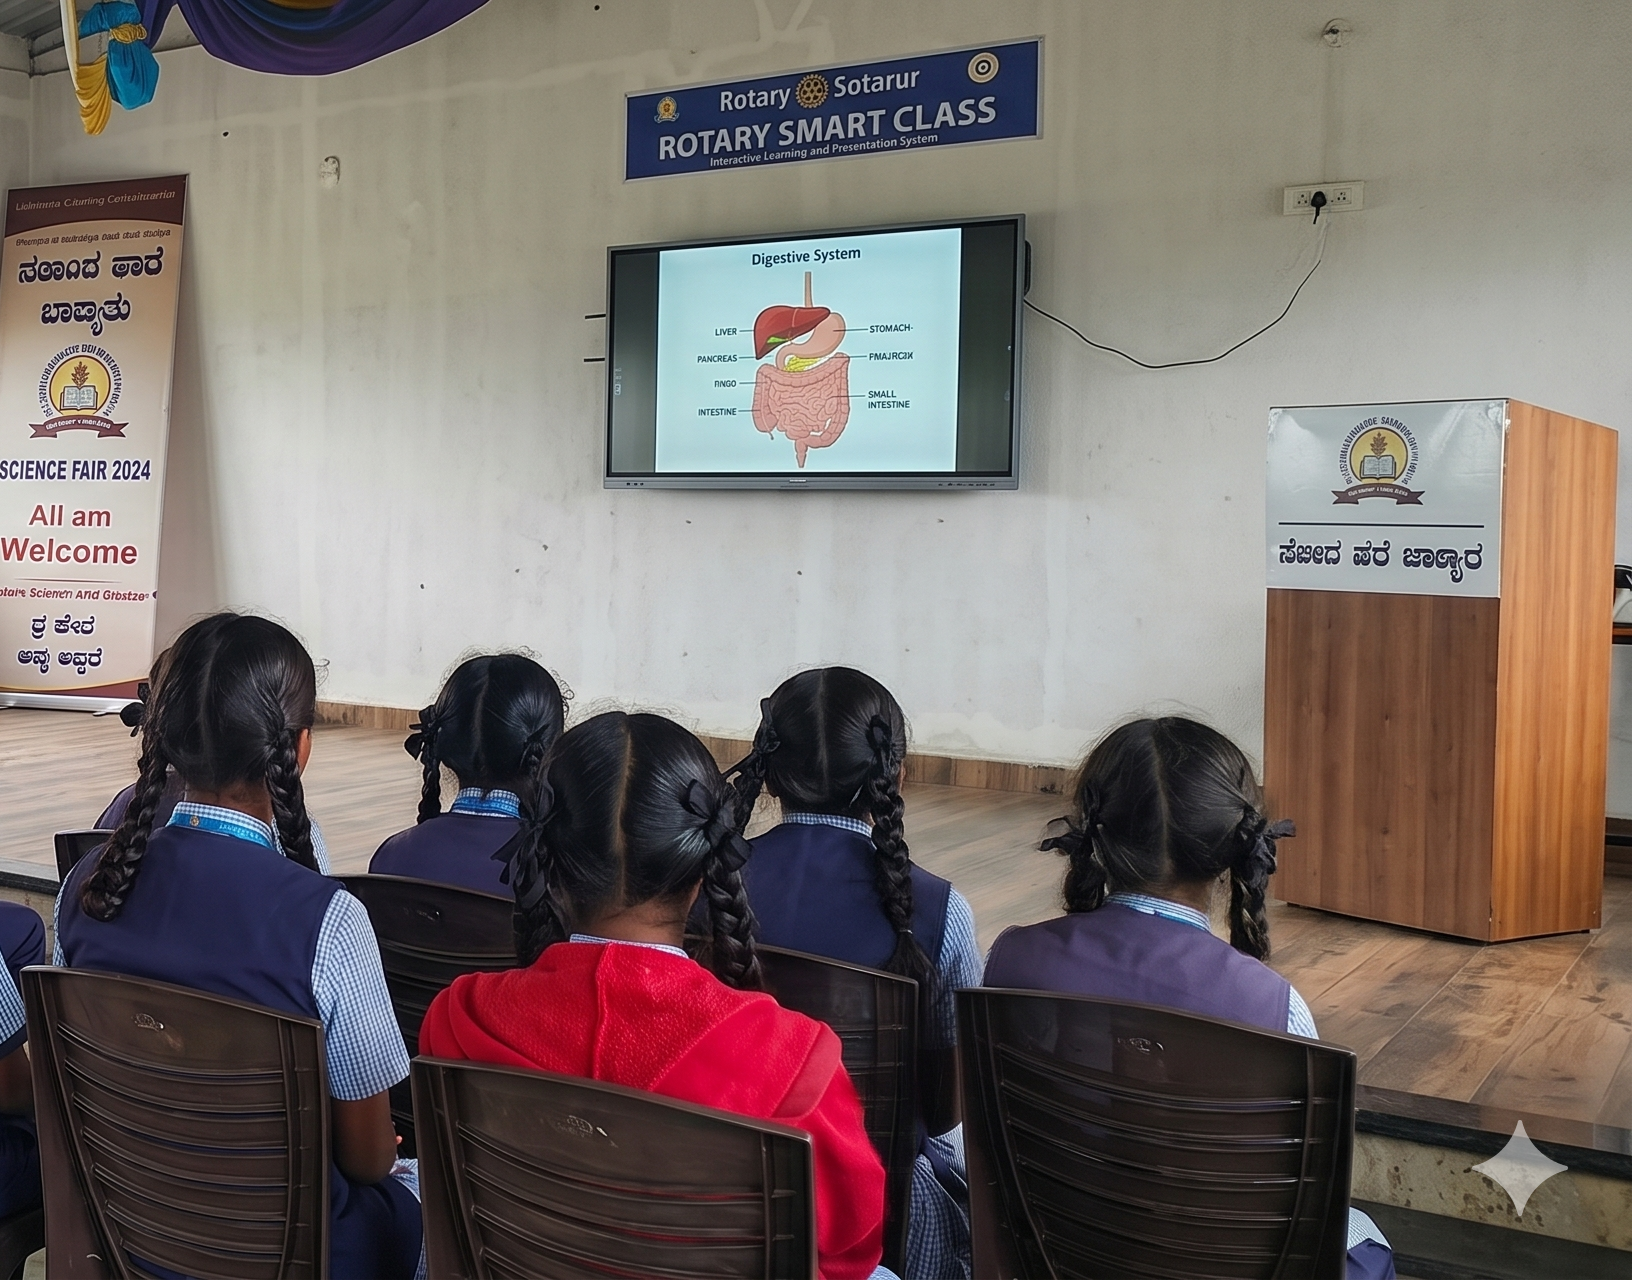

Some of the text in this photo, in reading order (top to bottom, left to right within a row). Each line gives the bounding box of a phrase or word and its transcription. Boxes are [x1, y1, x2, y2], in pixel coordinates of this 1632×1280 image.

[720, 70, 920, 112] Rotary Sotarur
[659, 96, 996, 160] ROTARY SMART CLASS
[710, 134, 938, 167] Interactive Learning and Presentation System
[751, 248, 861, 268] Digestive System
[714, 327, 737, 336] LIVER
[697, 354, 738, 363] PANCREAS
[868, 390, 897, 399] SMALL
[698, 407, 737, 416] INTESTINE
[868, 400, 911, 410] INTESTINE
[0, 460, 151, 480] SCIENCE FAIR 2024
[29, 504, 111, 527] All am
[0, 537, 138, 565] Welcome
